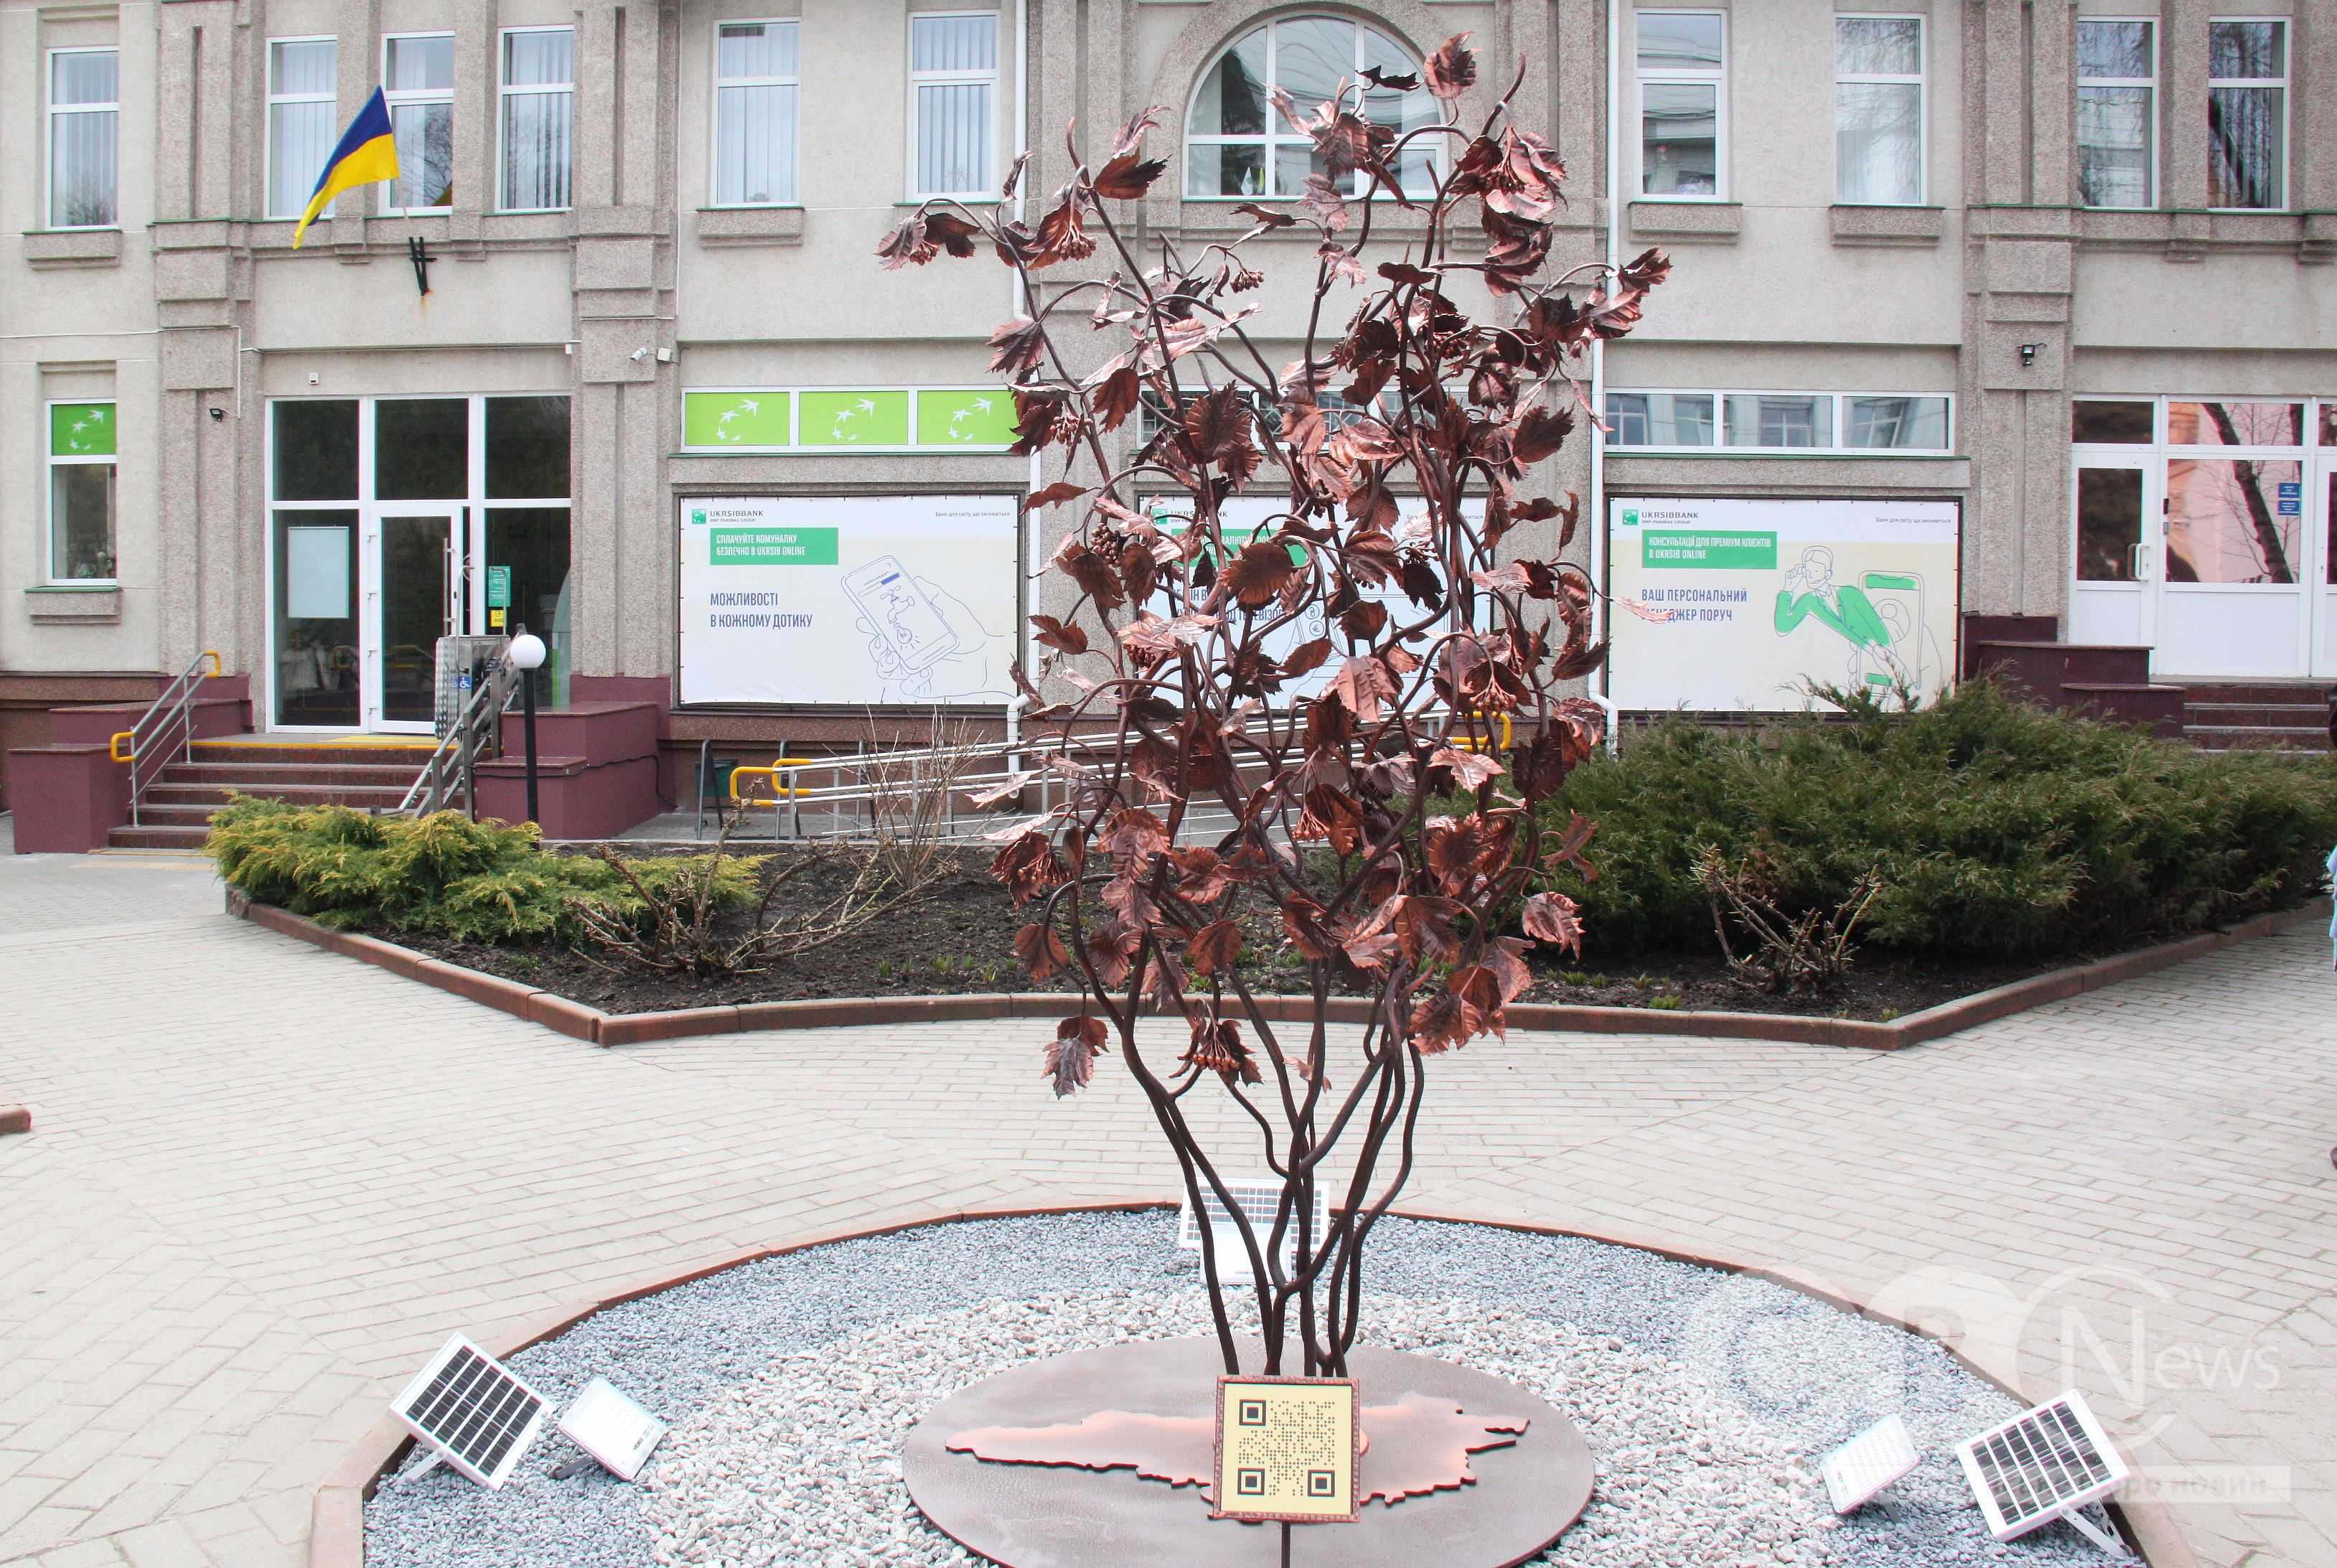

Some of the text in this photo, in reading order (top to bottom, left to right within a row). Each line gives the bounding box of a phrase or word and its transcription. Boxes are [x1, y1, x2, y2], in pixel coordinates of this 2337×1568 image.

[716, 532, 797, 544] СПЛАЧУЙТЕ КОМУНАЛКУ
[1649, 535, 1771, 548] КОНСУЛЬТАЦІЇ ДЛЯ ПРЕМІУМ КЛІЄНТІВ
[716, 546, 750, 556] БЕЗПЕЧНО
[757, 546, 781, 556] UKRSIB
[782, 546, 806, 556] ONLINE
[1655, 549, 1680, 559] UKRSIB
[1682, 550, 1707, 559] ONLINE
[710, 592, 778, 606] МОЖЛИВОСТІ
[1641, 587, 1747, 602] ВАШ ПЕРСОНАЛЬНИЙ
[1700, 609, 1733, 621] ПОРУЧ
[711, 614, 812, 630] В КОЖНОМУ ДОТИКУ
